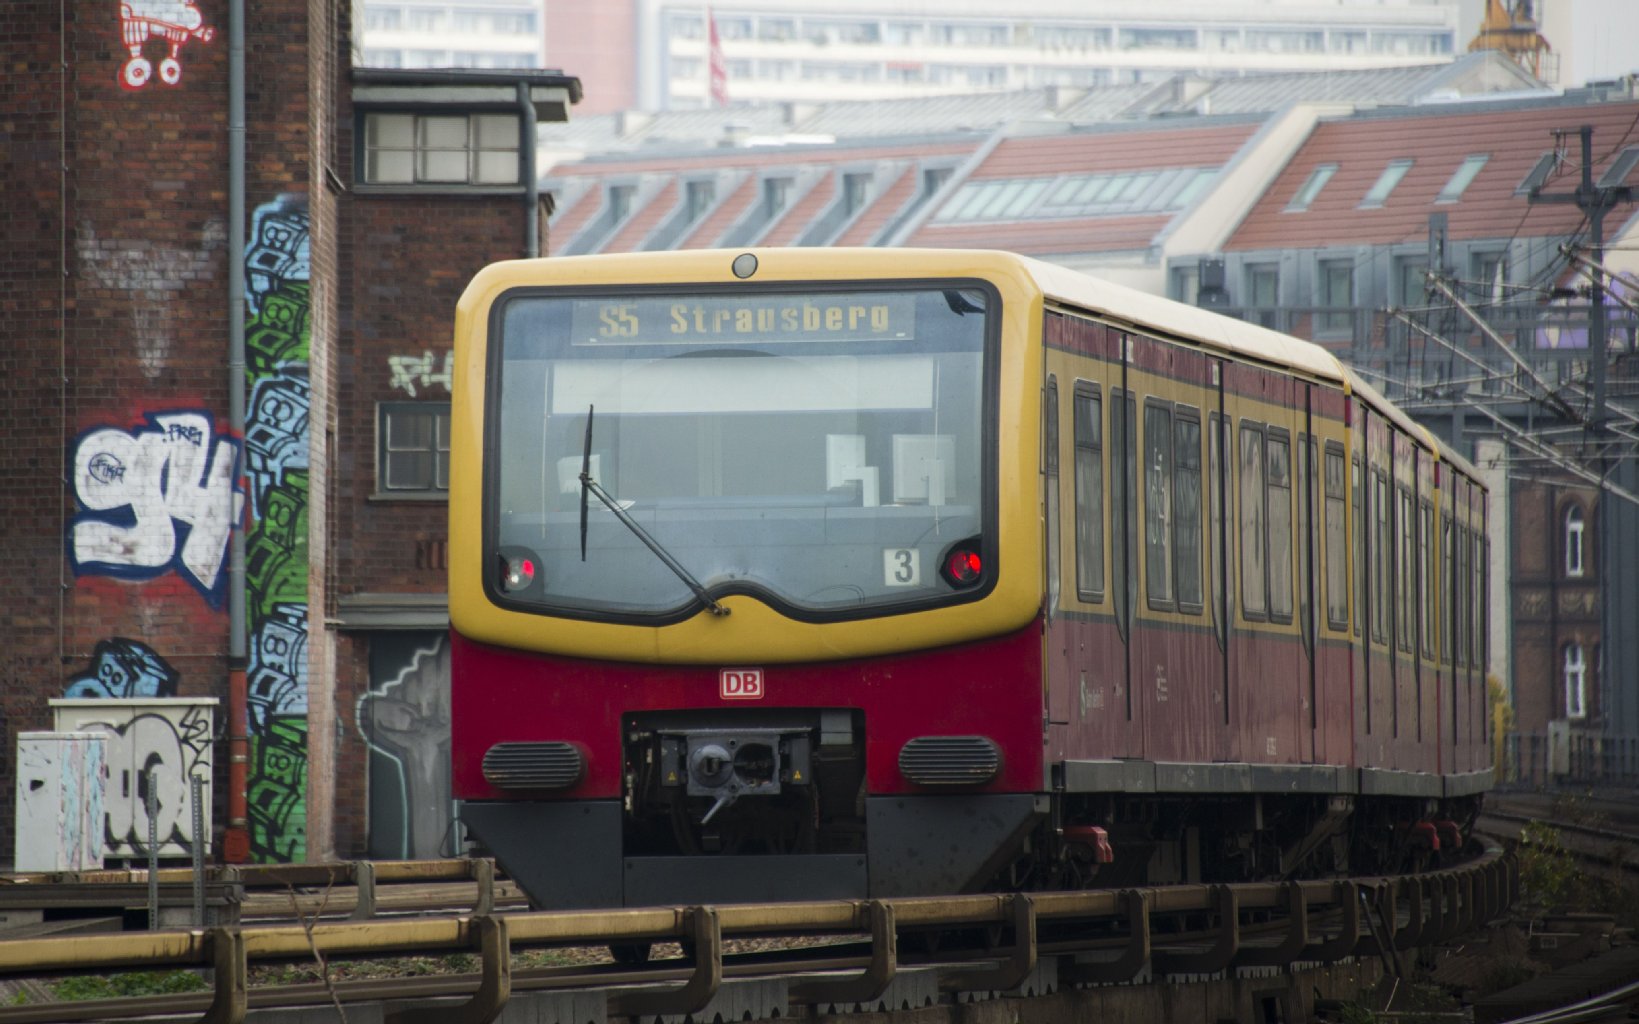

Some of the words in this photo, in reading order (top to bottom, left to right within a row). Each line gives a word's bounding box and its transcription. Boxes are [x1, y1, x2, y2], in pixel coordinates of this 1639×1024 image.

[600, 304, 639, 337] S5
[670, 303, 890, 334] Strausberg
[895, 550, 913, 583] 3
[725, 672, 758, 694] DB
